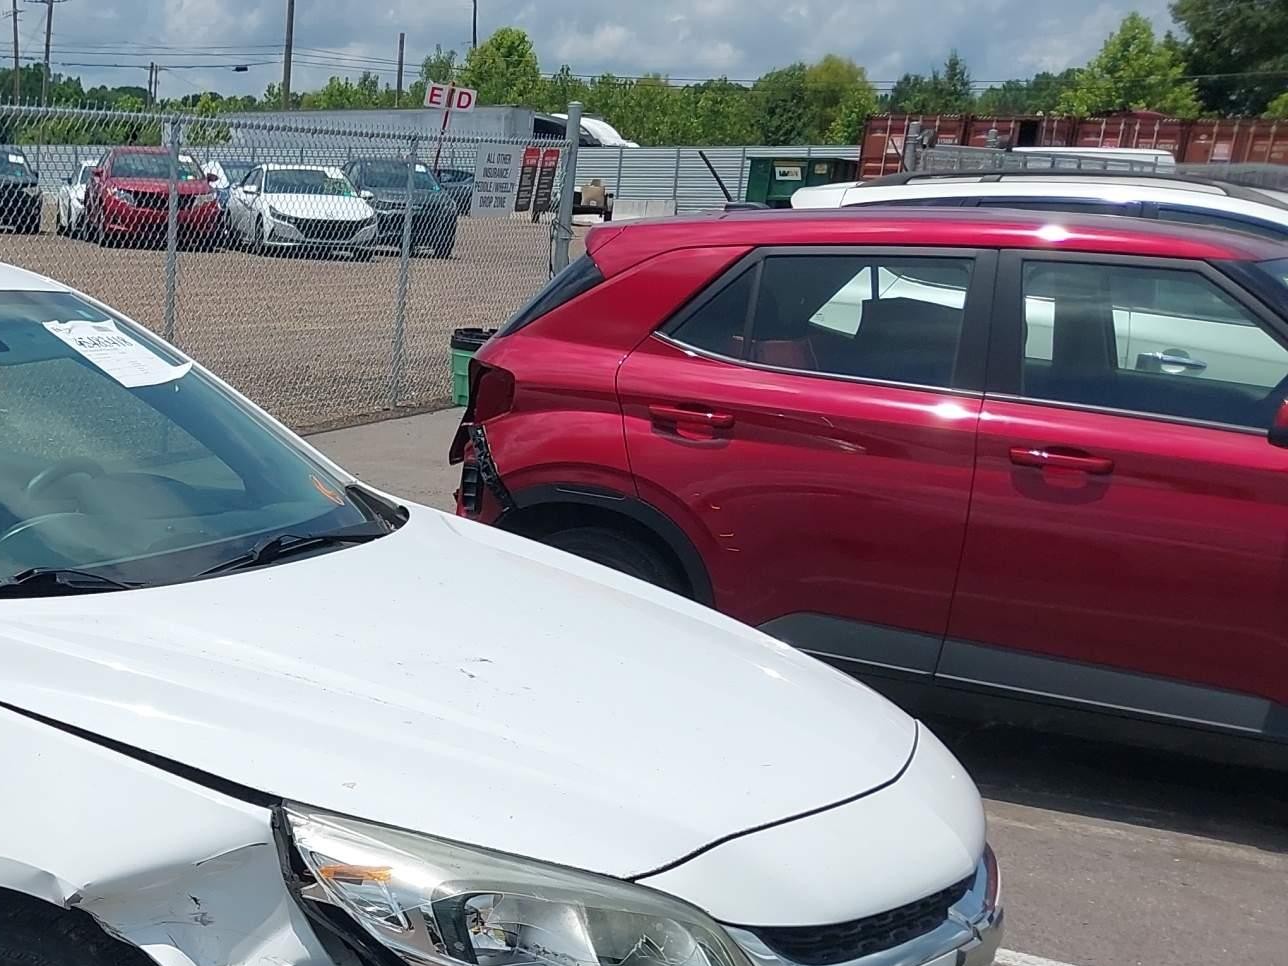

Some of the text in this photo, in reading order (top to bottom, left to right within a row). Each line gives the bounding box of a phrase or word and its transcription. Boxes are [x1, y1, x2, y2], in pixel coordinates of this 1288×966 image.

[486, 152, 496, 164] ALL
[497, 153, 512, 165] OTHER
[479, 195, 506, 208] DROP ZONE
